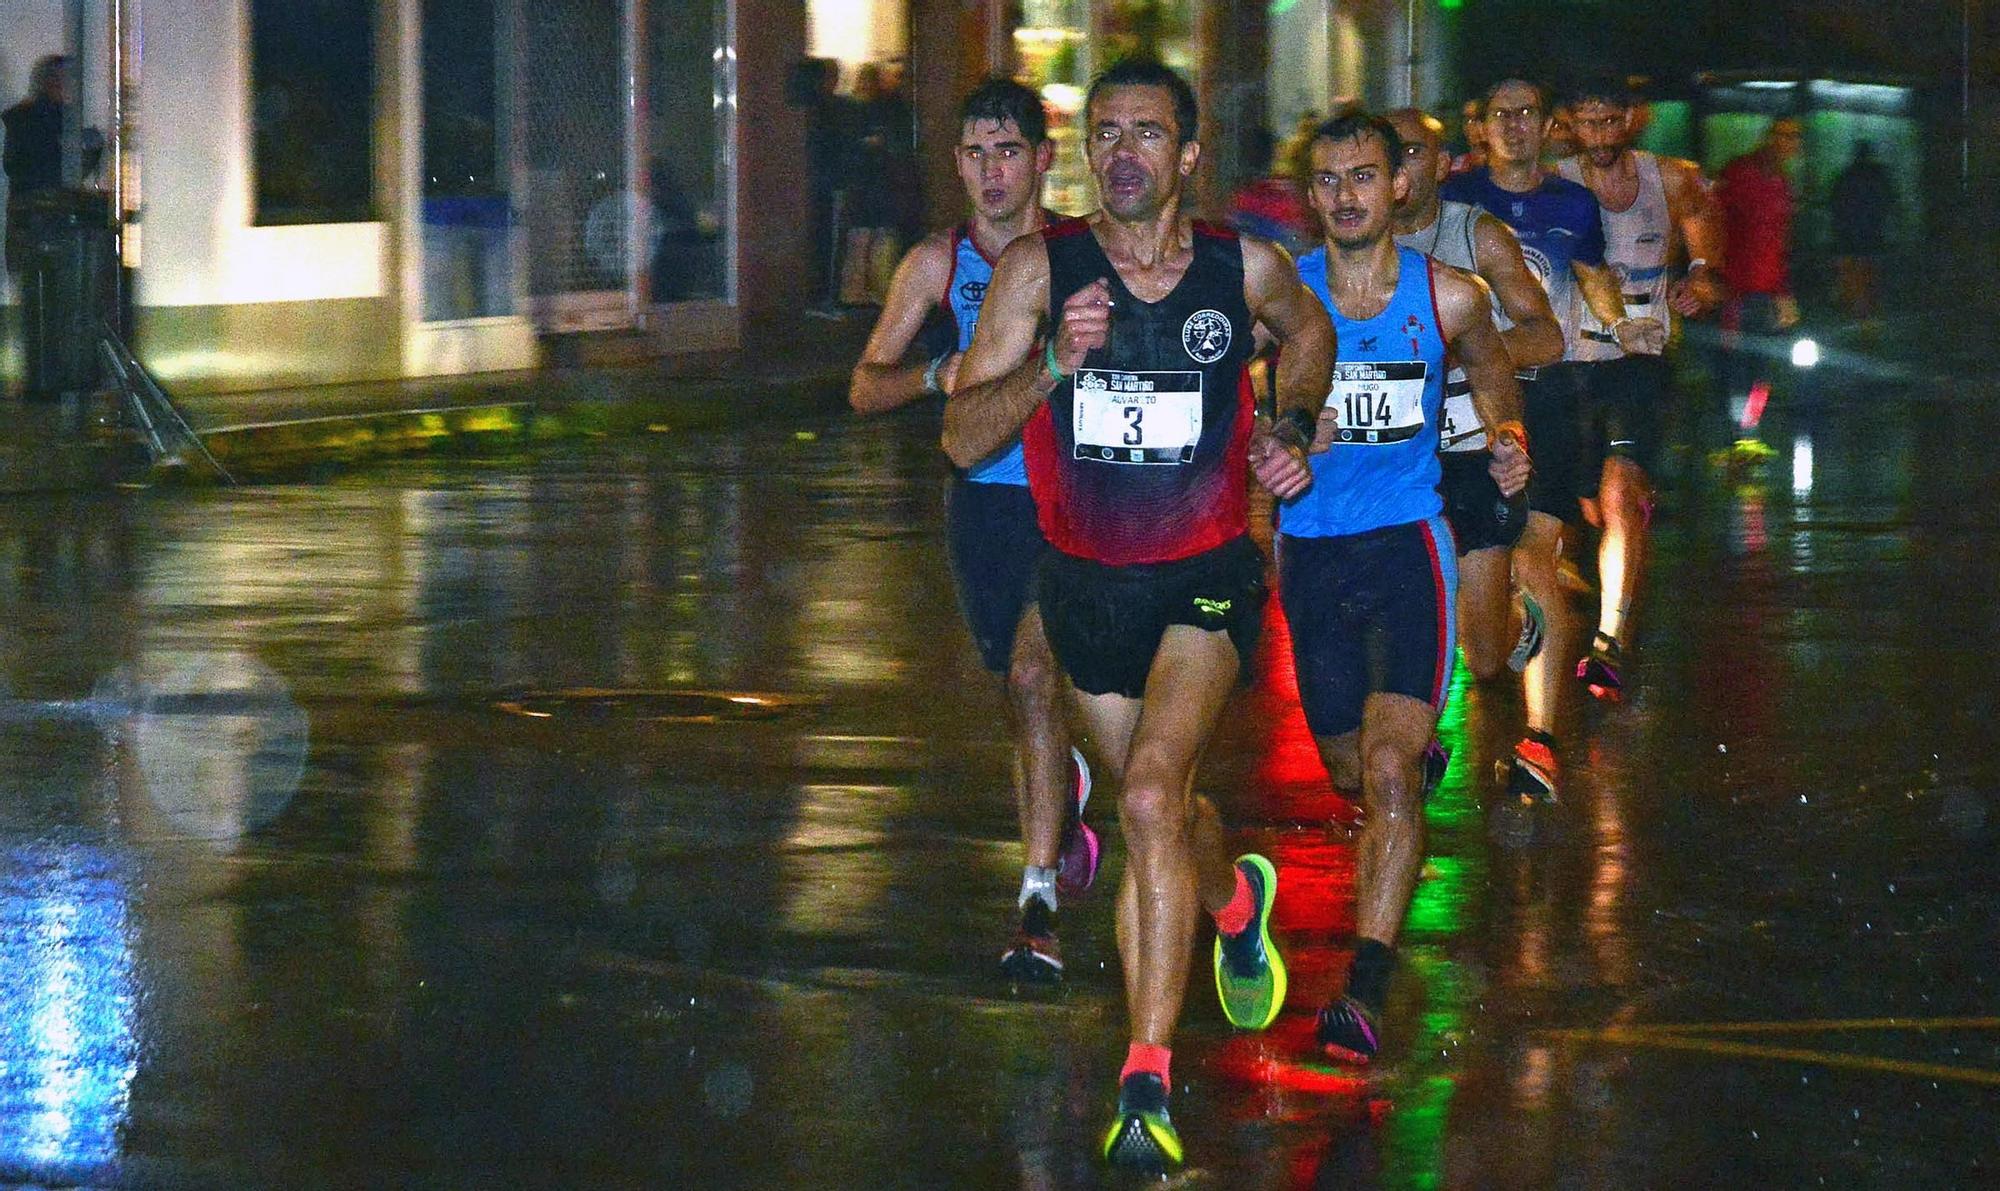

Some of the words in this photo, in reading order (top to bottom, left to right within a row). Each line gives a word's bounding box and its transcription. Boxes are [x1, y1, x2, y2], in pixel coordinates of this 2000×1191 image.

[1185, 320, 1194, 342] CLUBE
[1110, 381, 1124, 391] SAN
[1345, 370, 1360, 380] SAN
[1344, 392, 1392, 427] 104
[1123, 406, 1143, 445] 3
